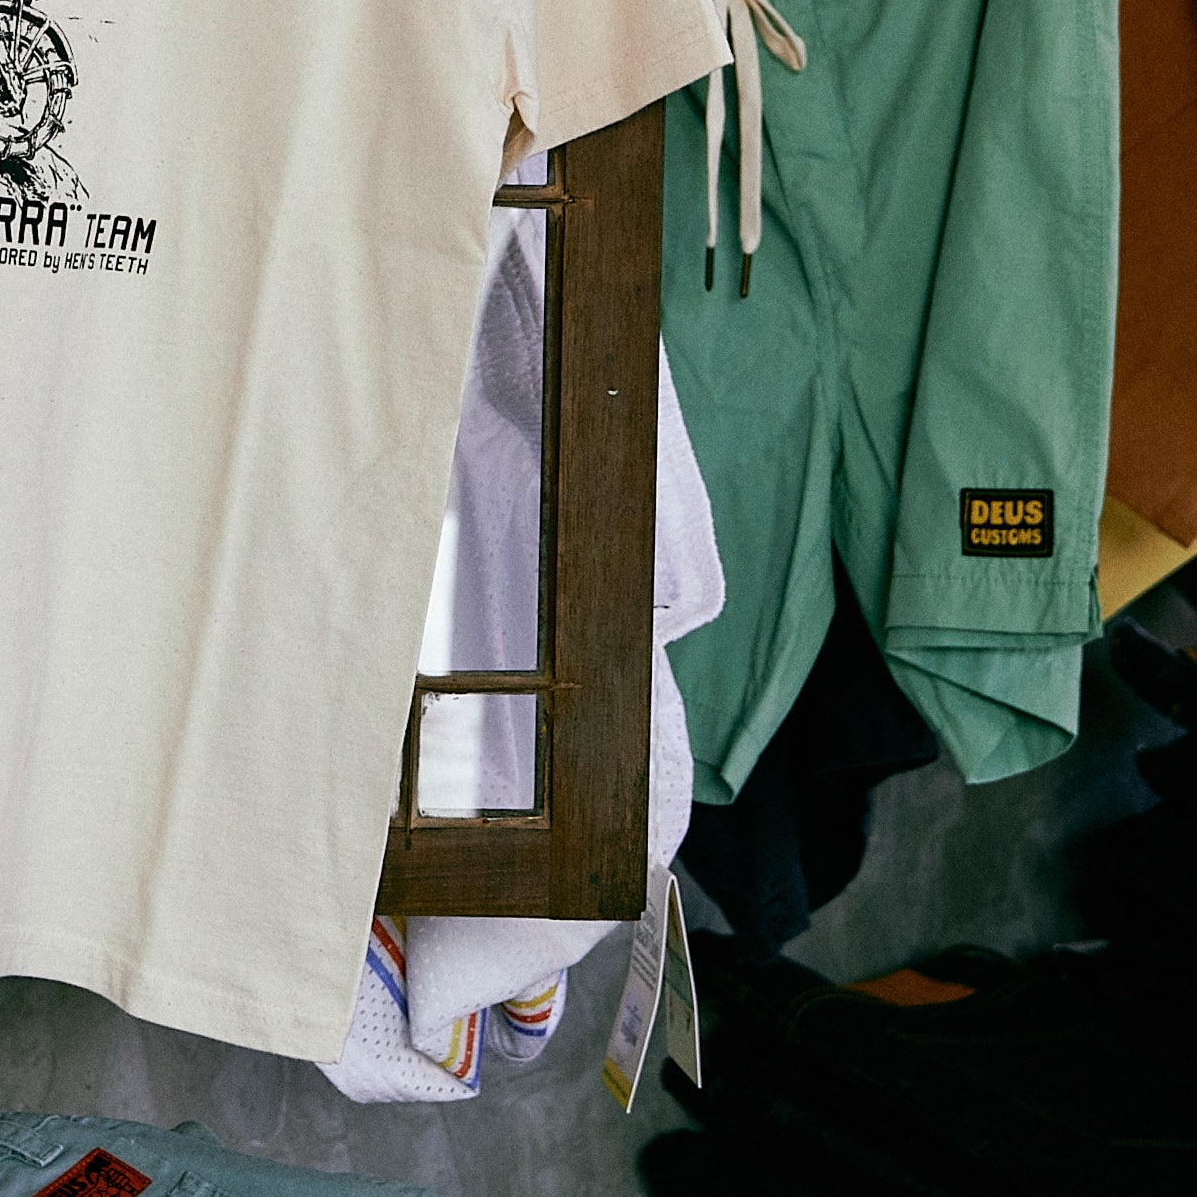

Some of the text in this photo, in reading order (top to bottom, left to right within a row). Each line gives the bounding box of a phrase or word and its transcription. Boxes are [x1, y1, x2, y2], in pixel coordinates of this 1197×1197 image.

[84, 213, 157, 254] TEAM
[43, 251, 61, 274] by
[99, 253, 149, 275] TEETH
[970, 499, 1044, 526] DEUS
[970, 527, 1043, 546] CUSTOMS
